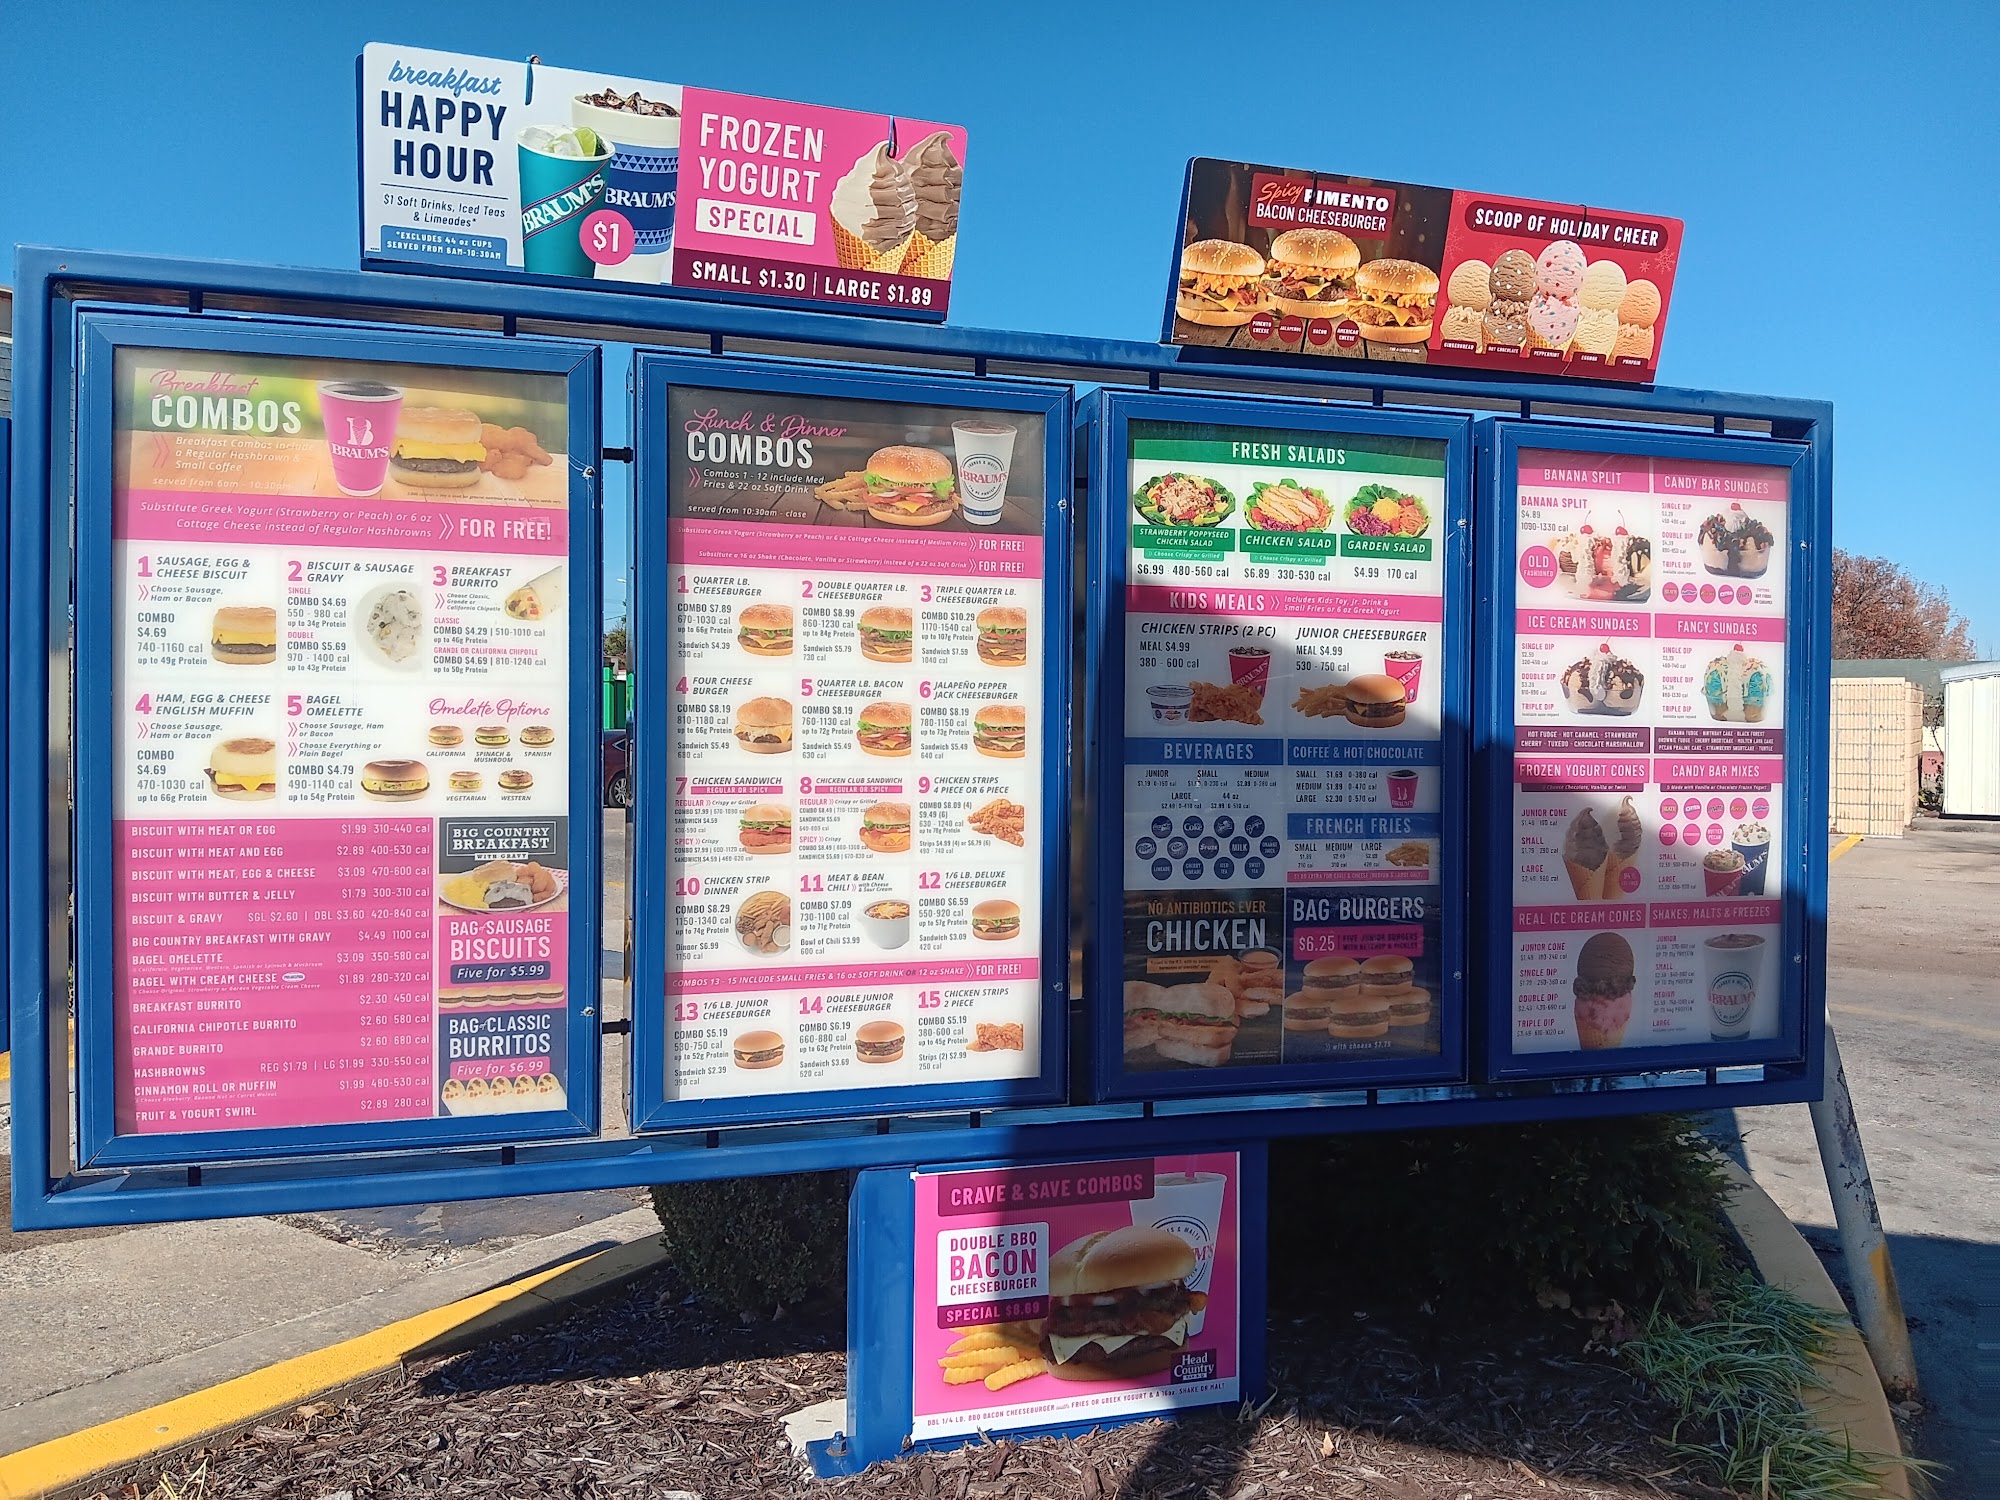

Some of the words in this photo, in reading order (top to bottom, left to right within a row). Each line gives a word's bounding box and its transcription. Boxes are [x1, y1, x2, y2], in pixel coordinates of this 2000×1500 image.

[388, 58, 501, 100] breakfast
[381, 90, 506, 141] HAPPY
[699, 111, 824, 163] FROZEN
[394, 139, 493, 186] HOUR
[697, 155, 820, 204] YOGURT
[383, 193, 393, 205] $1
[397, 195, 417, 207] Soft
[421, 198, 454, 212] Drinks,
[458, 203, 479, 214] Iced
[484, 205, 505, 217] Teas
[522, 173, 606, 235] BRAUM'S
[605, 186, 677, 210] BRAUM'S
[1257, 182, 1304, 206] Spicy
[1304, 188, 1389, 212] PIMENTO
[413, 211, 419, 221] &
[708, 206, 804, 238] SPECIAL
[1256, 203, 1295, 221] BACON
[1297, 208, 1387, 231] CHEESEBURGER
[1473, 208, 1523, 229] SCOOP
[1526, 214, 1546, 232] OF
[1549, 218, 1609, 240] HOLIDAY
[1613, 226, 1658, 246] CHEER
[444, 236, 455, 244] 44
[470, 238, 492, 249] CUPS
[591, 220, 620, 254] $1
[387, 240, 418, 251] SERVED
[421, 244, 443, 253] FROM
[446, 247, 500, 259] 6AM-10:30AM
[692, 260, 751, 284] SMALL
[758, 268, 805, 291] $1.30
[824, 276, 881, 299] LARGE
[887, 283, 932, 305] $1.89
[148, 367, 260, 401] Breakfast
[150, 393, 302, 435] COMBOS
[685, 407, 753, 433] Lunch
[761, 414, 774, 433] &
[781, 415, 846, 441] Dinner
[331, 442, 389, 460] BRAUM'S
[687, 430, 814, 469] COMBOS
[1232, 441, 1280, 460] FRESH
[1288, 445, 1345, 464] SALADS
[1544, 467, 1587, 484] BANANA
[1592, 470, 1621, 484] SPLIT
[1664, 474, 1697, 489] CANDY
[1700, 478, 1720, 491] BAR
[1724, 480, 1768, 494] SUNDAES
[688, 504, 717, 513] served
[717, 506, 738, 515] from
[742, 505, 776, 517] 10:30am
[786, 510, 806, 518] close
[460, 517, 495, 537] FOR
[503, 517, 551, 541] FREE!
[979, 538, 997, 550] FOR
[999, 539, 1025, 552] FREE!
[1245, 535, 1293, 546] CHICKEN
[1297, 537, 1331, 548] SALAD
[1347, 540, 1389, 551] GARDEN
[1393, 542, 1425, 553] SALAD
[138, 555, 152, 577] 1
[156, 556, 211, 567] SAUSAGE,
[215, 558, 238, 567] EGG
[242, 559, 250, 568] &
[1527, 554, 1549, 568] OLD
[156, 568, 199, 578] CHEESE
[202, 570, 247, 580] BISCUIT
[307, 573, 344, 582] GRAVY
[1354, 566, 1379, 578] $4.99
[1387, 568, 1401, 579] 170
[1404, 569, 1416, 580] cal
[1523, 567, 1554, 578] FASHIONED
[817, 581, 851, 590] DOUBLE
[854, 582, 892, 592] QUARTER
[817, 591, 882, 600] CHEESEBURGER
[1170, 591, 1206, 609] KIDS
[1215, 593, 1264, 611] MEALS
[137, 612, 174, 623] COMBO
[802, 607, 830, 616] COMBO
[833, 608, 854, 617] $8.99
[137, 626, 166, 637] $4.69
[1141, 622, 1195, 634] CHICKEN
[1198, 624, 1239, 635] STRIPS
[1242, 624, 1253, 638] (2
[1256, 624, 1276, 639] PC)
[1295, 627, 1338, 640] JUNIOR
[1342, 628, 1426, 641] CHEESEBURGER
[1678, 620, 1709, 633] FANCY
[1713, 622, 1757, 635] SUNDAES
[137, 657, 147, 665] up
[160, 656, 175, 666] 49g
[178, 656, 207, 665] Protein
[429, 697, 494, 715] Omelette
[496, 698, 550, 719] Options
[1164, 742, 1253, 759] BEVERAGES
[1671, 764, 1704, 776] CANDY
[1709, 765, 1728, 776] BAR
[1731, 765, 1759, 777] MIXES
[130, 826, 172, 836] BISCUIT
[176, 825, 204, 835] WITH
[208, 824, 235, 836] MEAT
[239, 824, 252, 834] OR
[256, 824, 275, 834] EGG
[341, 823, 367, 834] $1.99
[373, 824, 411, 834] 310-440
[415, 823, 429, 833] cal
[453, 828, 478, 837] BIG
[483, 827, 549, 838] COUNTRY
[1307, 818, 1363, 834] FRENCH
[1371, 818, 1410, 833] FRIES
[452, 837, 550, 850] BREAKFAST
[1292, 898, 1329, 922] BAG
[1338, 896, 1424, 920] BURGERS
[1145, 917, 1267, 952] CHICKEN
[1299, 935, 1335, 951] $6.25
[451, 936, 550, 960] BISCUITS
[457, 967, 482, 978] Five
[485, 966, 505, 979] for
[510, 964, 543, 977] $5.99
[944, 989, 980, 997] CHICKEN
[982, 987, 1008, 996] STRIPS
[450, 1033, 550, 1058] BURRITOS
[136, 1110, 165, 1121] FRUIT
[168, 1110, 176, 1119] &
[181, 1108, 220, 1118] YOGURT
[225, 1106, 256, 1116] SWIRL
[950, 1184, 1005, 1206] CRAVE
[1012, 1183, 1023, 1200] &
[1029, 1179, 1070, 1199] SAVE
[1077, 1174, 1142, 1195] COMBOS
[950, 1234, 1004, 1251] DOUBLE
[1011, 1231, 1036, 1247] BBQ
[949, 1247, 1037, 1281] BACON
[950, 1277, 1036, 1296] CHEESEBURGER
[946, 1305, 1000, 1322] SPECIAL
[1181, 1351, 1208, 1367] Head
[1173, 1360, 1215, 1377] Country
